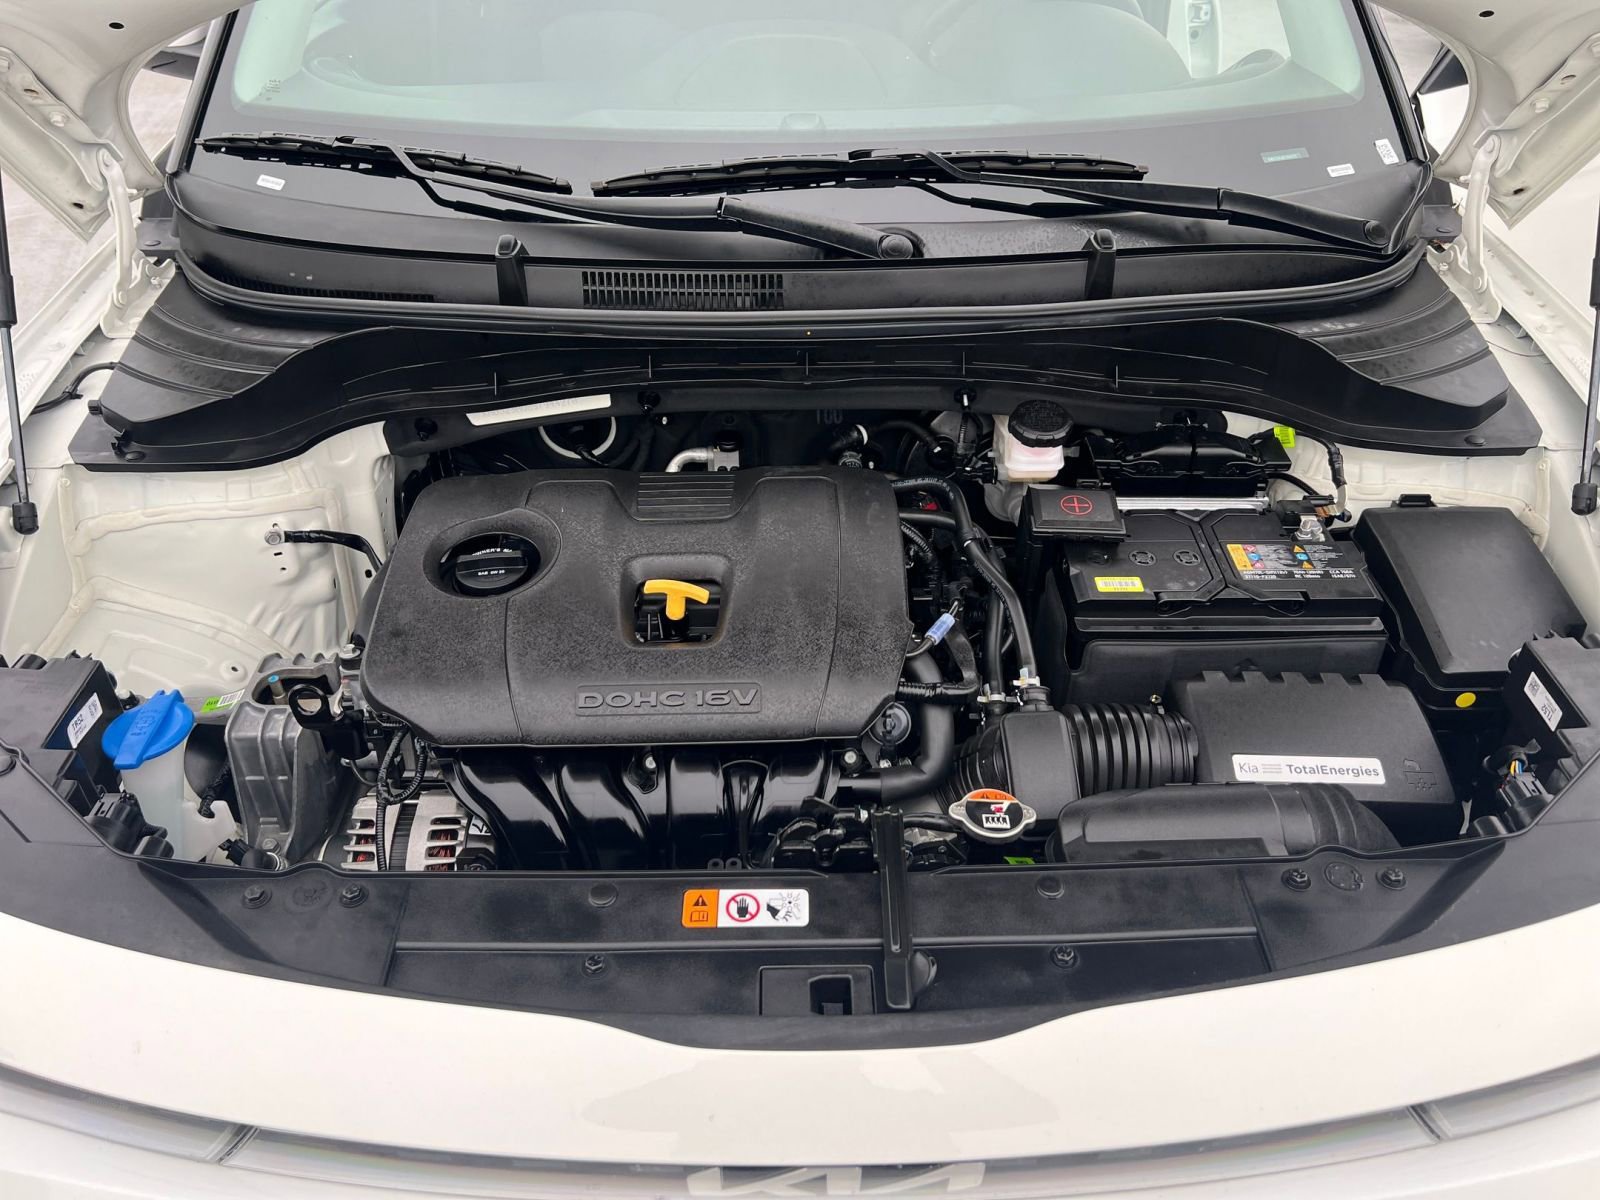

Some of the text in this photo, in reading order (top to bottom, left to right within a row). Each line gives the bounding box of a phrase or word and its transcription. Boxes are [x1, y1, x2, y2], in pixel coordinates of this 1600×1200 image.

[578, 688, 759, 709] DOHC 16V
[1541, 703, 1553, 721] TL52
[1238, 762, 1380, 778] Kia TotalEnergies
